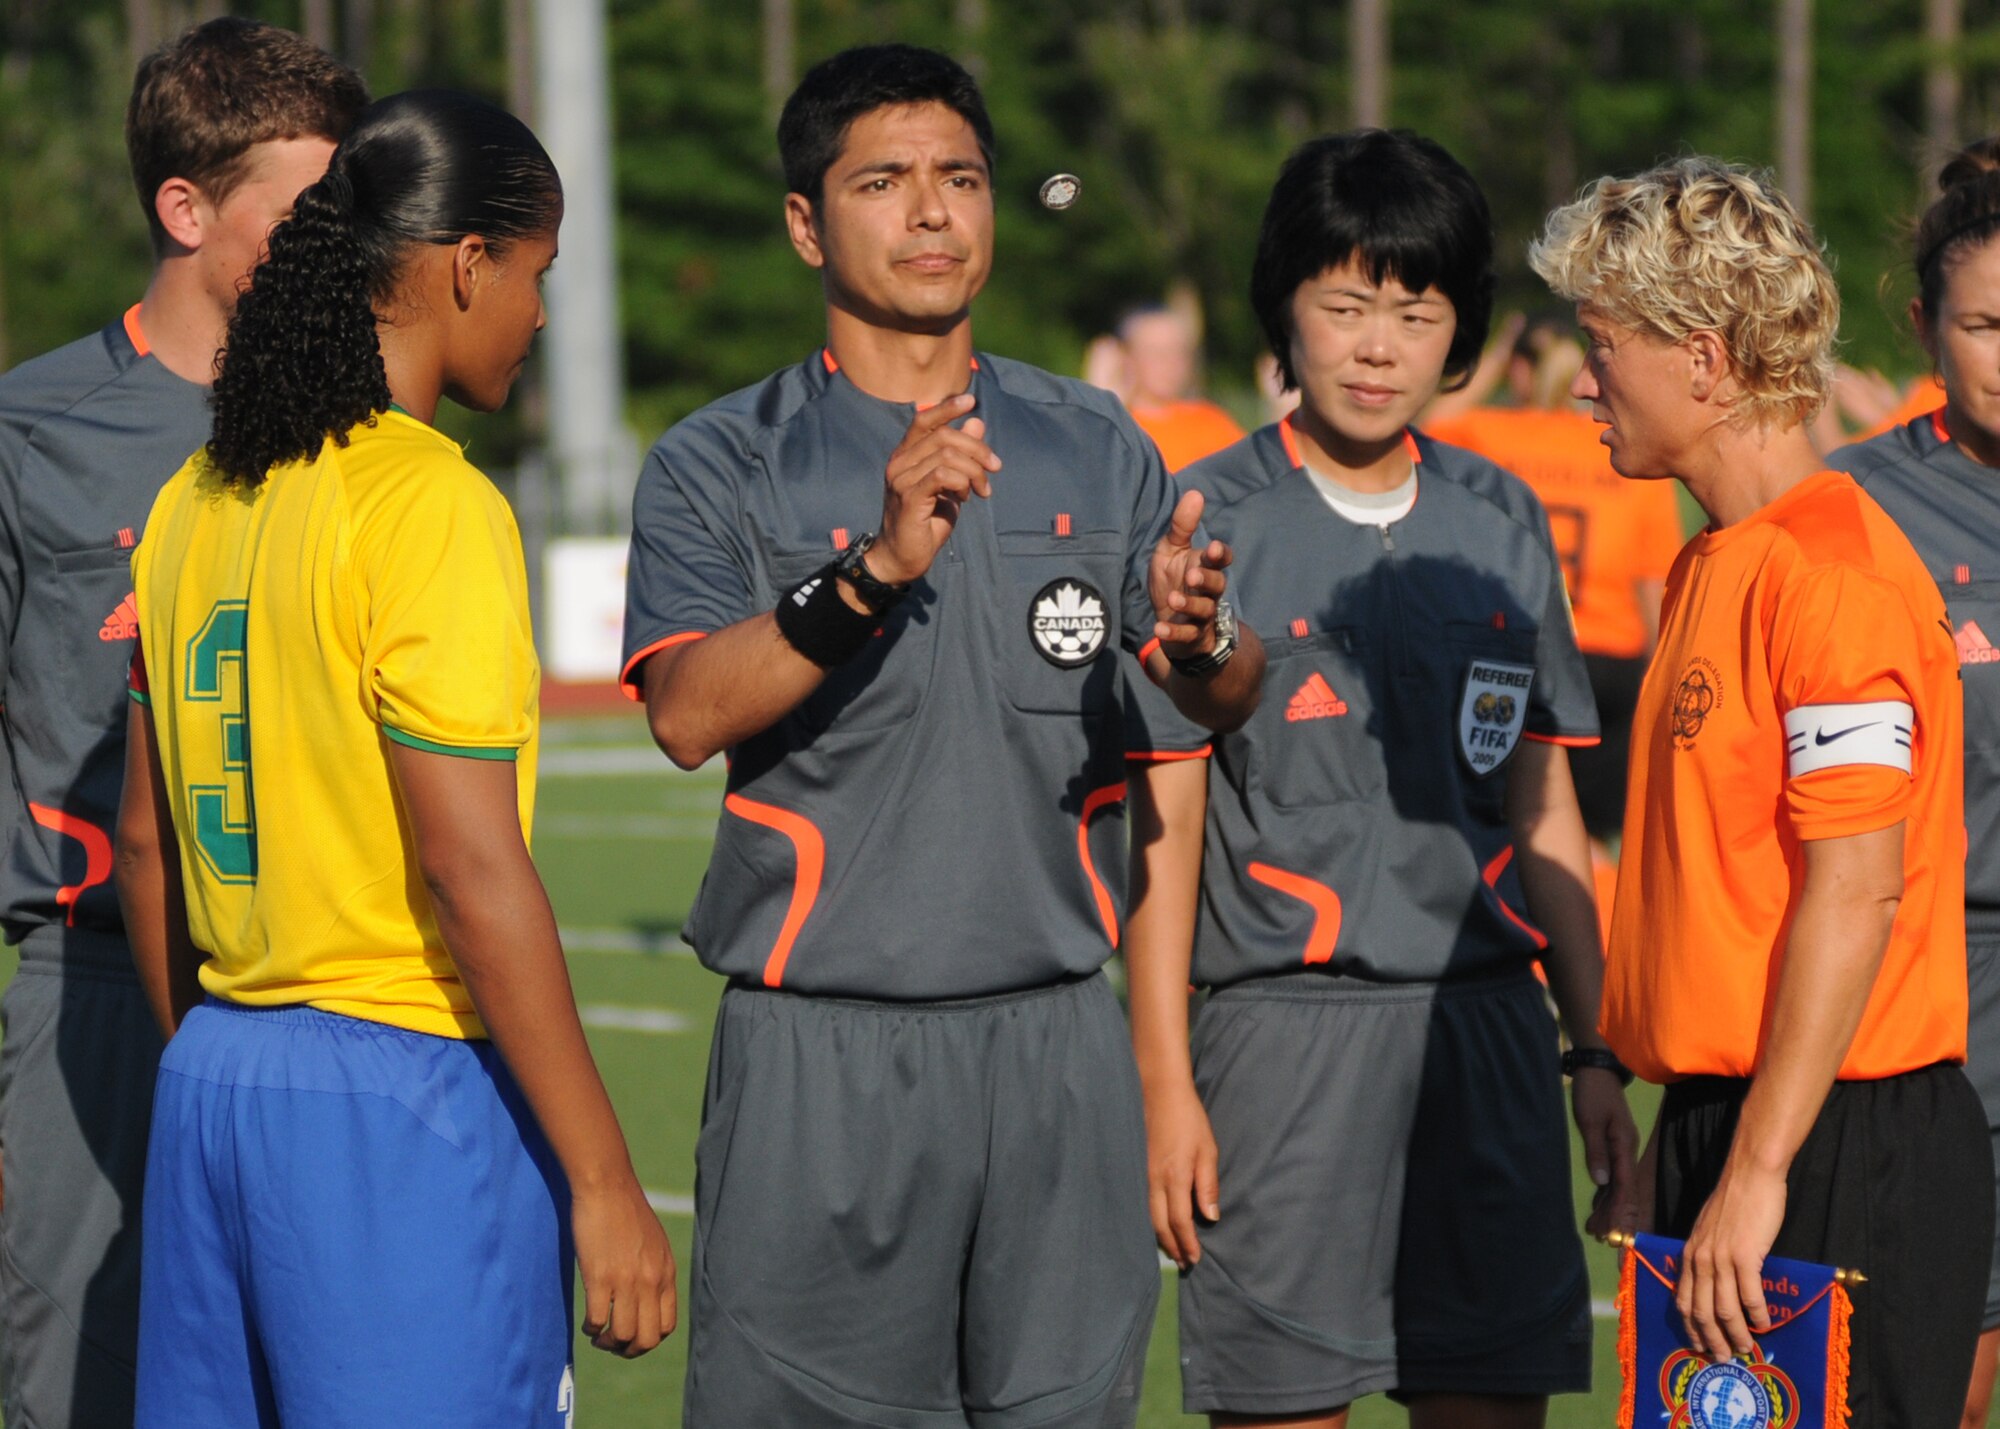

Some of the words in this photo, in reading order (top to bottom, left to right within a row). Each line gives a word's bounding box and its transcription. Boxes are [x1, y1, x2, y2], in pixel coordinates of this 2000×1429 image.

[1033, 616, 1105, 630] CANADA
[1472, 666, 1532, 689] REFEREE
[1286, 700, 1348, 722] adidas
[184, 599, 259, 886] 3
[1469, 726, 1508, 749] FIFA
[1692, 1366, 1740, 1410] INTERNATIONAL
[1741, 1373, 1755, 1386] DU
[1752, 1386, 1766, 1419] SPORT
